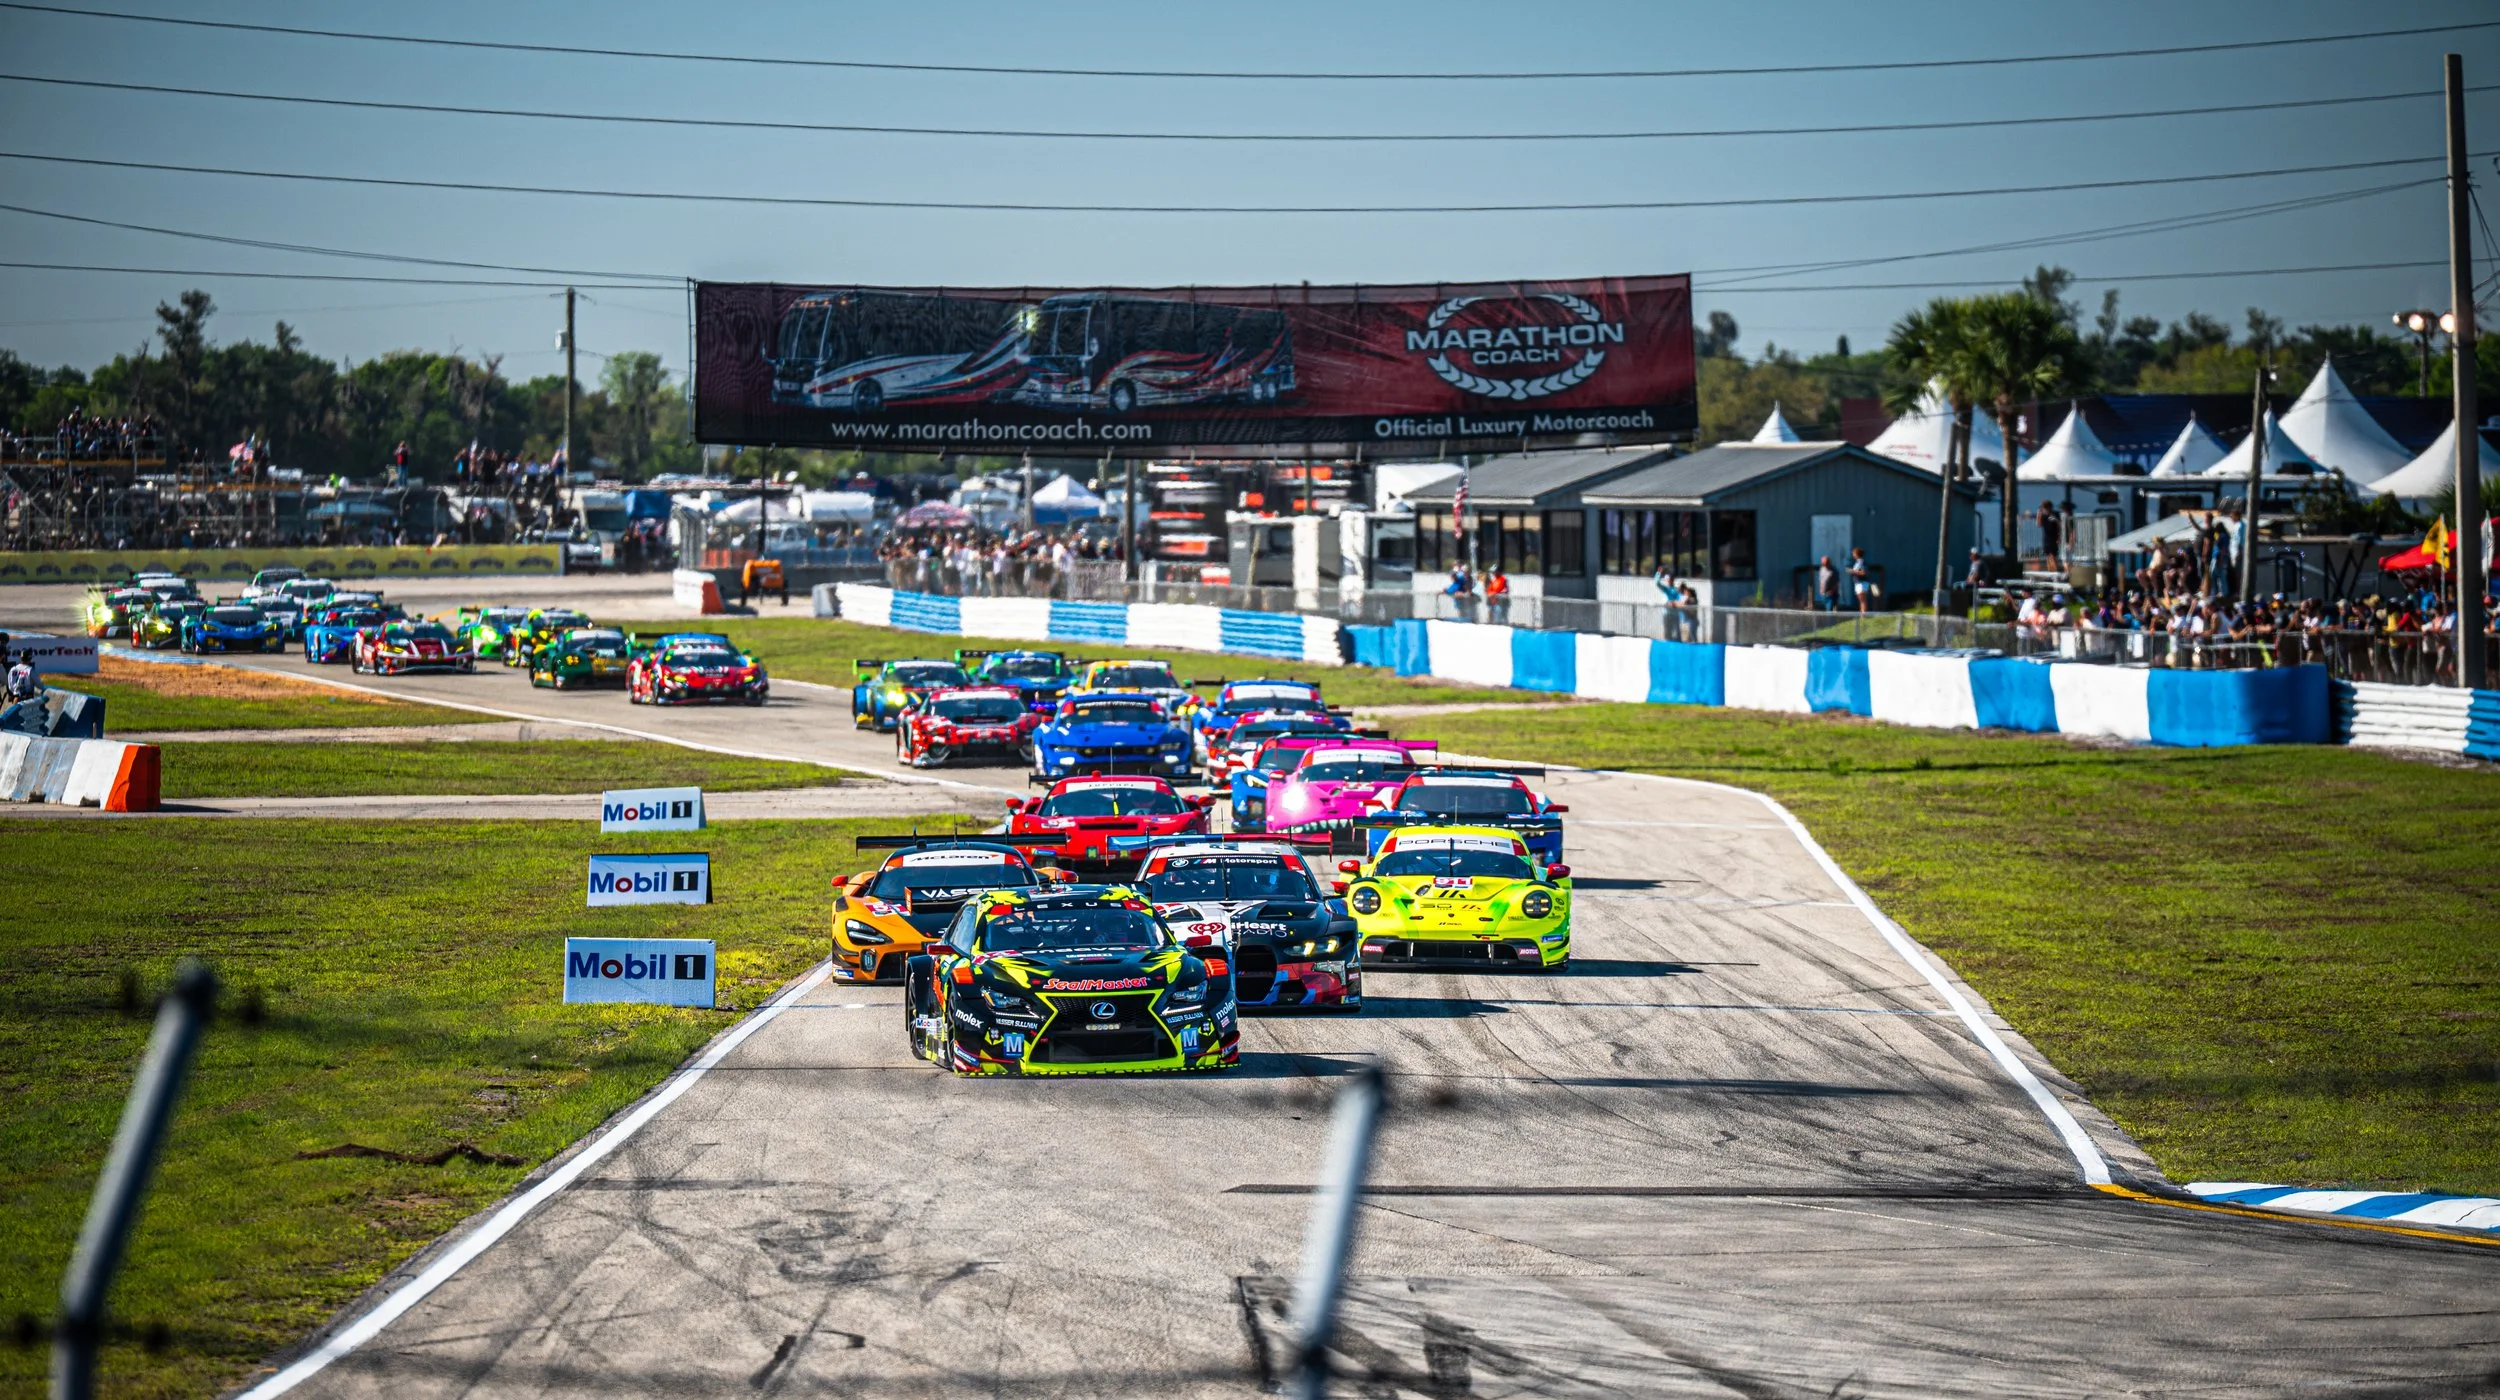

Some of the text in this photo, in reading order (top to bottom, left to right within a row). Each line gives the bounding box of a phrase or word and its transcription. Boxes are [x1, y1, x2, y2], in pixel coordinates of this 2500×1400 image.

[1407, 323, 1624, 350] MARATHON
[1472, 348, 1560, 364] COACH
[831, 417, 1152, 440] www.marathoncoach.com
[1374, 410, 1654, 441] Official Luxury Motorcoach
[602, 801, 668, 822] Mobil
[1399, 838, 1511, 850] PORSCHE
[589, 871, 668, 893] Mobil
[568, 951, 667, 980] Mobil
[1043, 976, 1149, 991] SealMaster
[955, 1008, 985, 1029] molex
[1006, 1035, 1022, 1053] M
[1183, 1029, 1198, 1048] M
